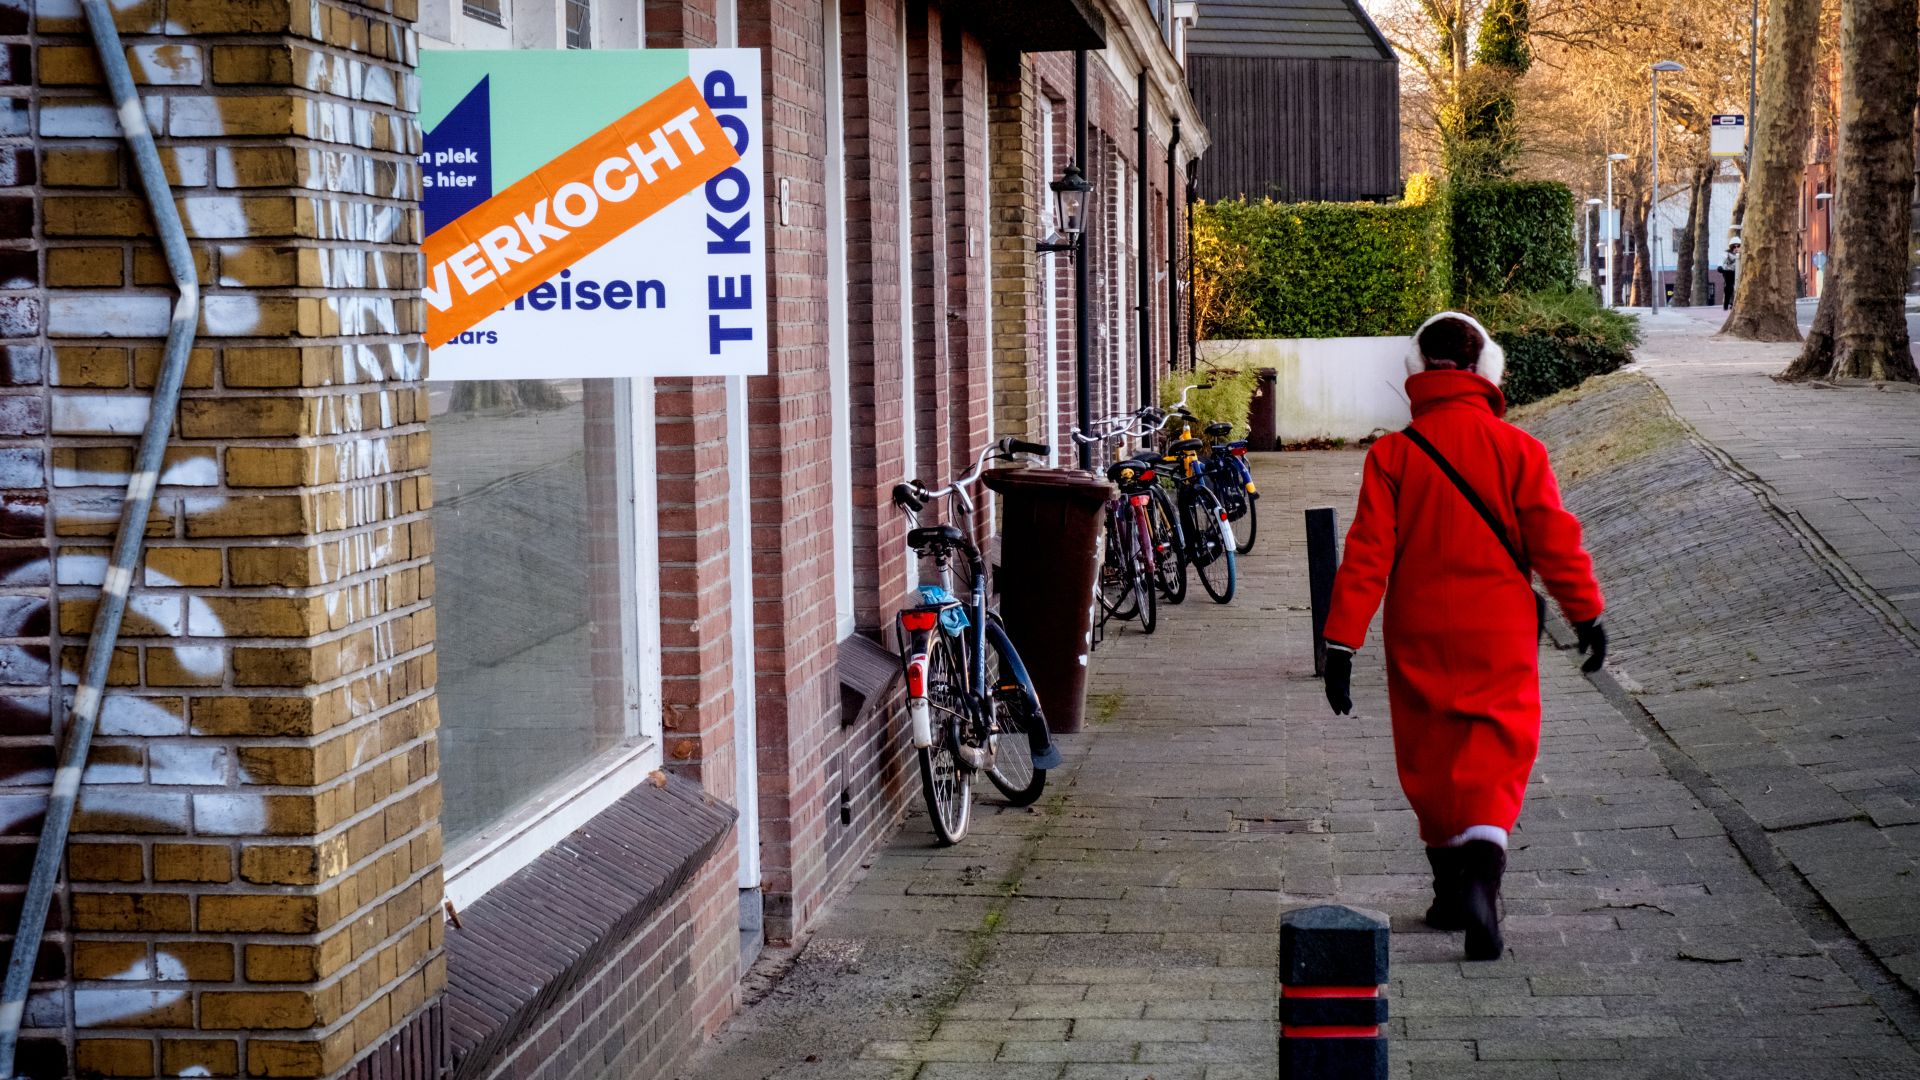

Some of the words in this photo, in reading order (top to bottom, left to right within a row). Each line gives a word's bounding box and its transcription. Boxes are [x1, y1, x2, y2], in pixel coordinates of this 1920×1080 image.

[435, 147, 479, 167] plek
[437, 170, 477, 188] hier
[703, 69, 751, 255] KOOP
[421, 105, 706, 313] VERKOCHT
[708, 274, 753, 355] TE
